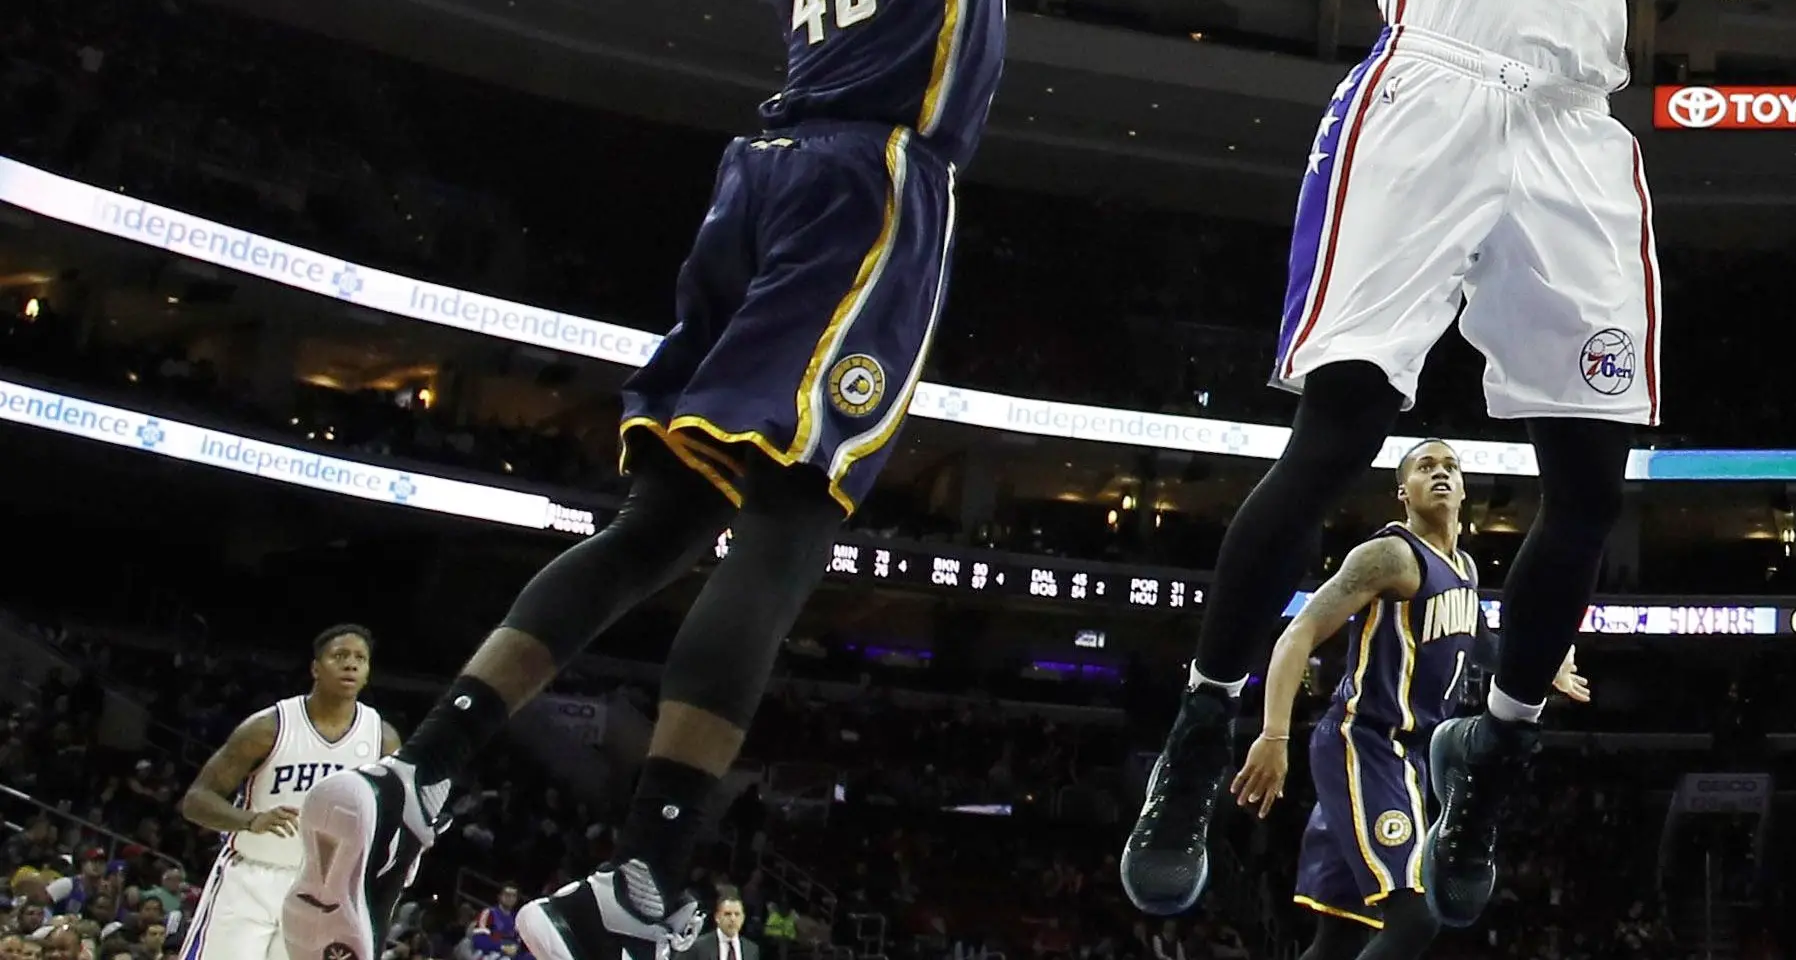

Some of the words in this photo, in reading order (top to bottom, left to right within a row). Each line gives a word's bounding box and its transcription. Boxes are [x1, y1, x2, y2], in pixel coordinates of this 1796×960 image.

[93, 192, 325, 283] Independence
[409, 284, 632, 355] Independence
[1006, 401, 1212, 443] Independence
[200, 434, 381, 491] Independence
[833, 544, 859, 560] MIN
[831, 557, 858, 574] ORL
[933, 557, 960, 573] BKN
[931, 570, 958, 586] CHA
[1031, 568, 1056, 584] DAL
[1030, 581, 1057, 597] BOS
[1095, 581, 1105, 594] 2
[1131, 578, 1159, 593] POR
[1171, 581, 1185, 595] 31
[1129, 591, 1157, 606] HOU
[1169, 594, 1184, 608] 31
[1194, 590, 1203, 604] 2
[1670, 608, 1755, 633] SIXERS
[269, 762, 344, 794] PH
